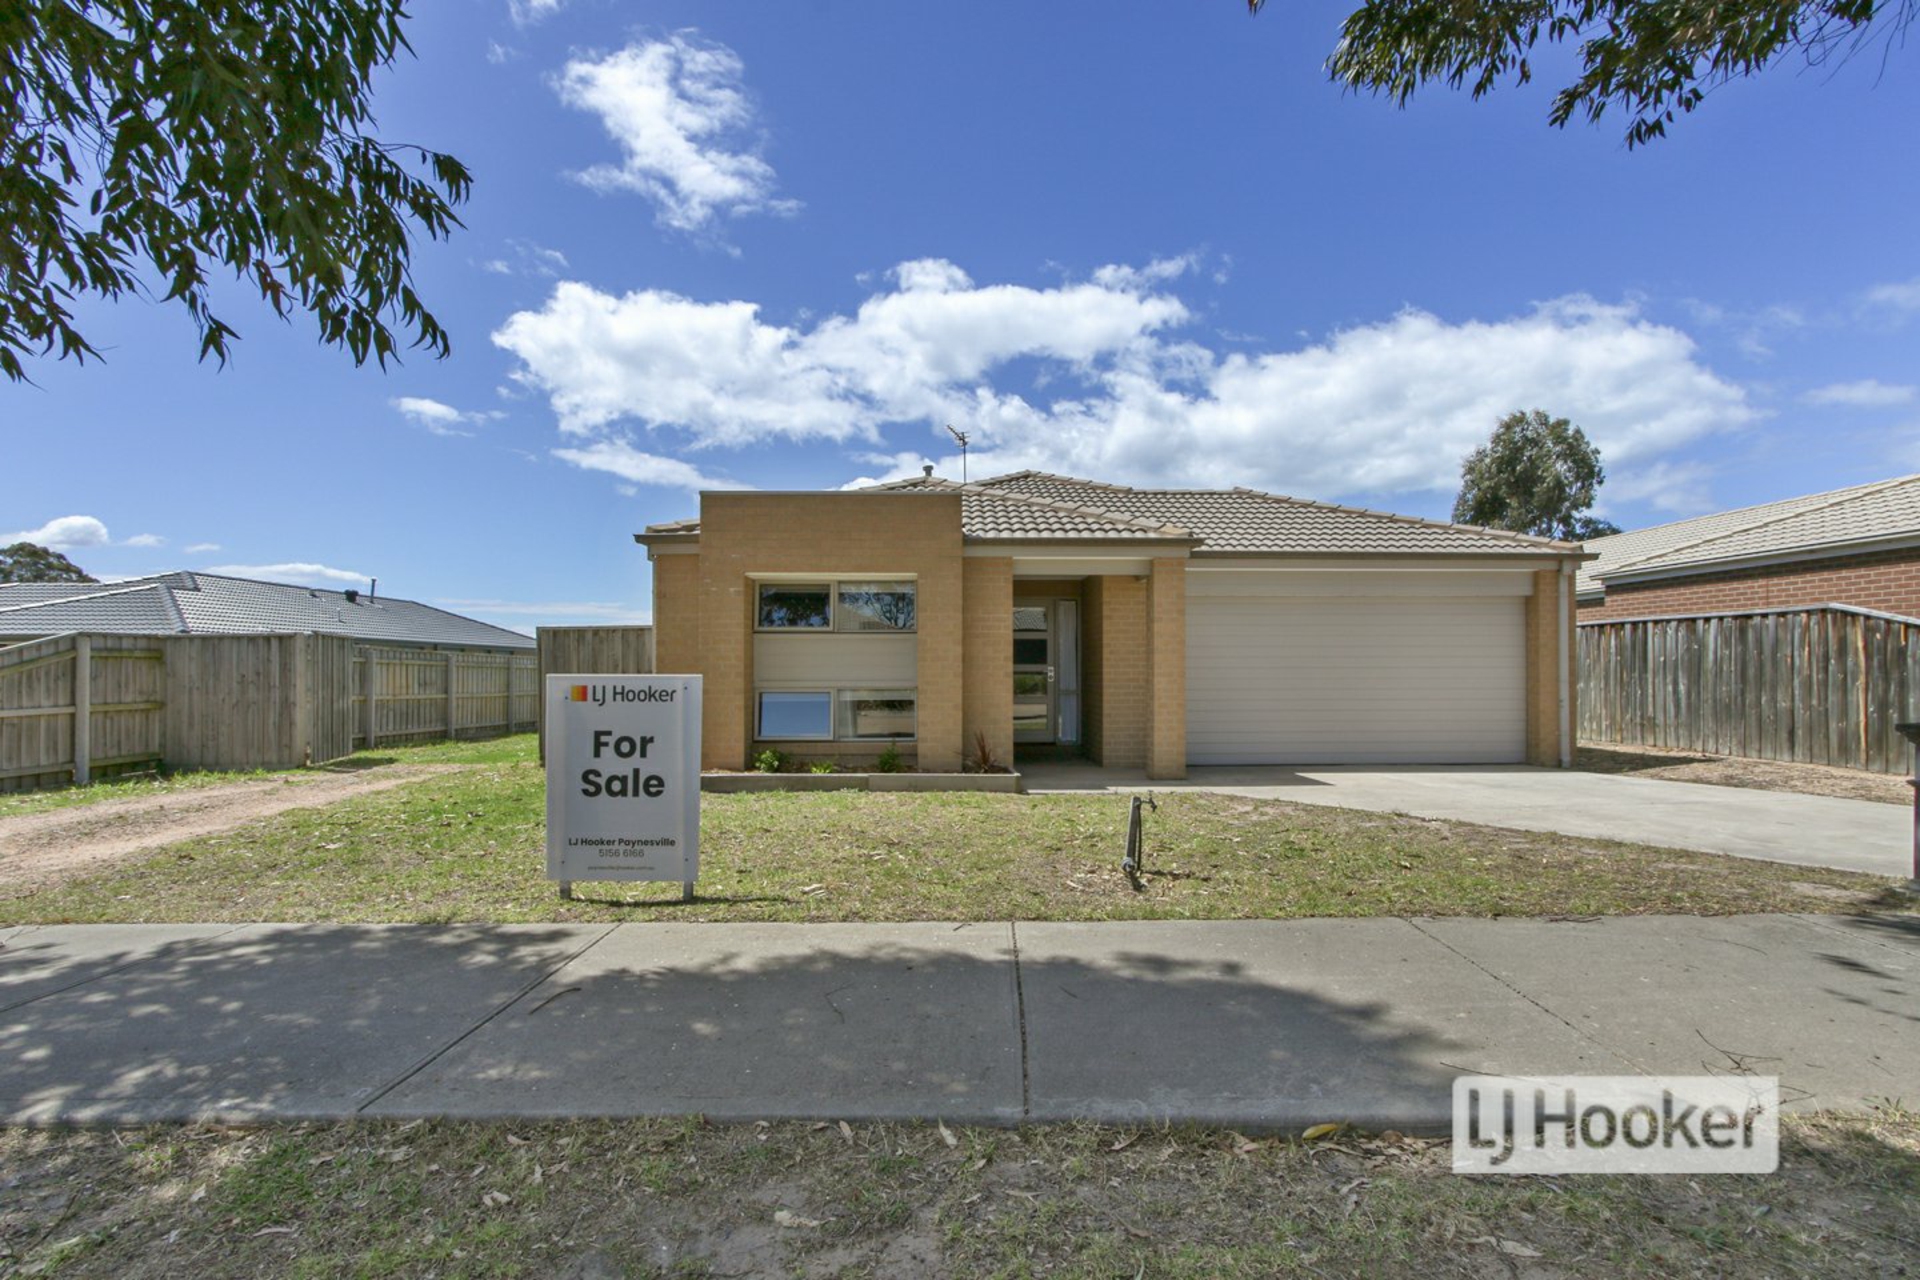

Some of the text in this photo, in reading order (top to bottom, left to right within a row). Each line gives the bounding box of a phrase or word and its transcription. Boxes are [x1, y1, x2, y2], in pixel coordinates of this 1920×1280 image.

[592, 684, 677, 706] LJ Hooker
[593, 730, 655, 759] For
[581, 767, 665, 798] Sale
[568, 837, 676, 848] LJ Hooker Paynesville
